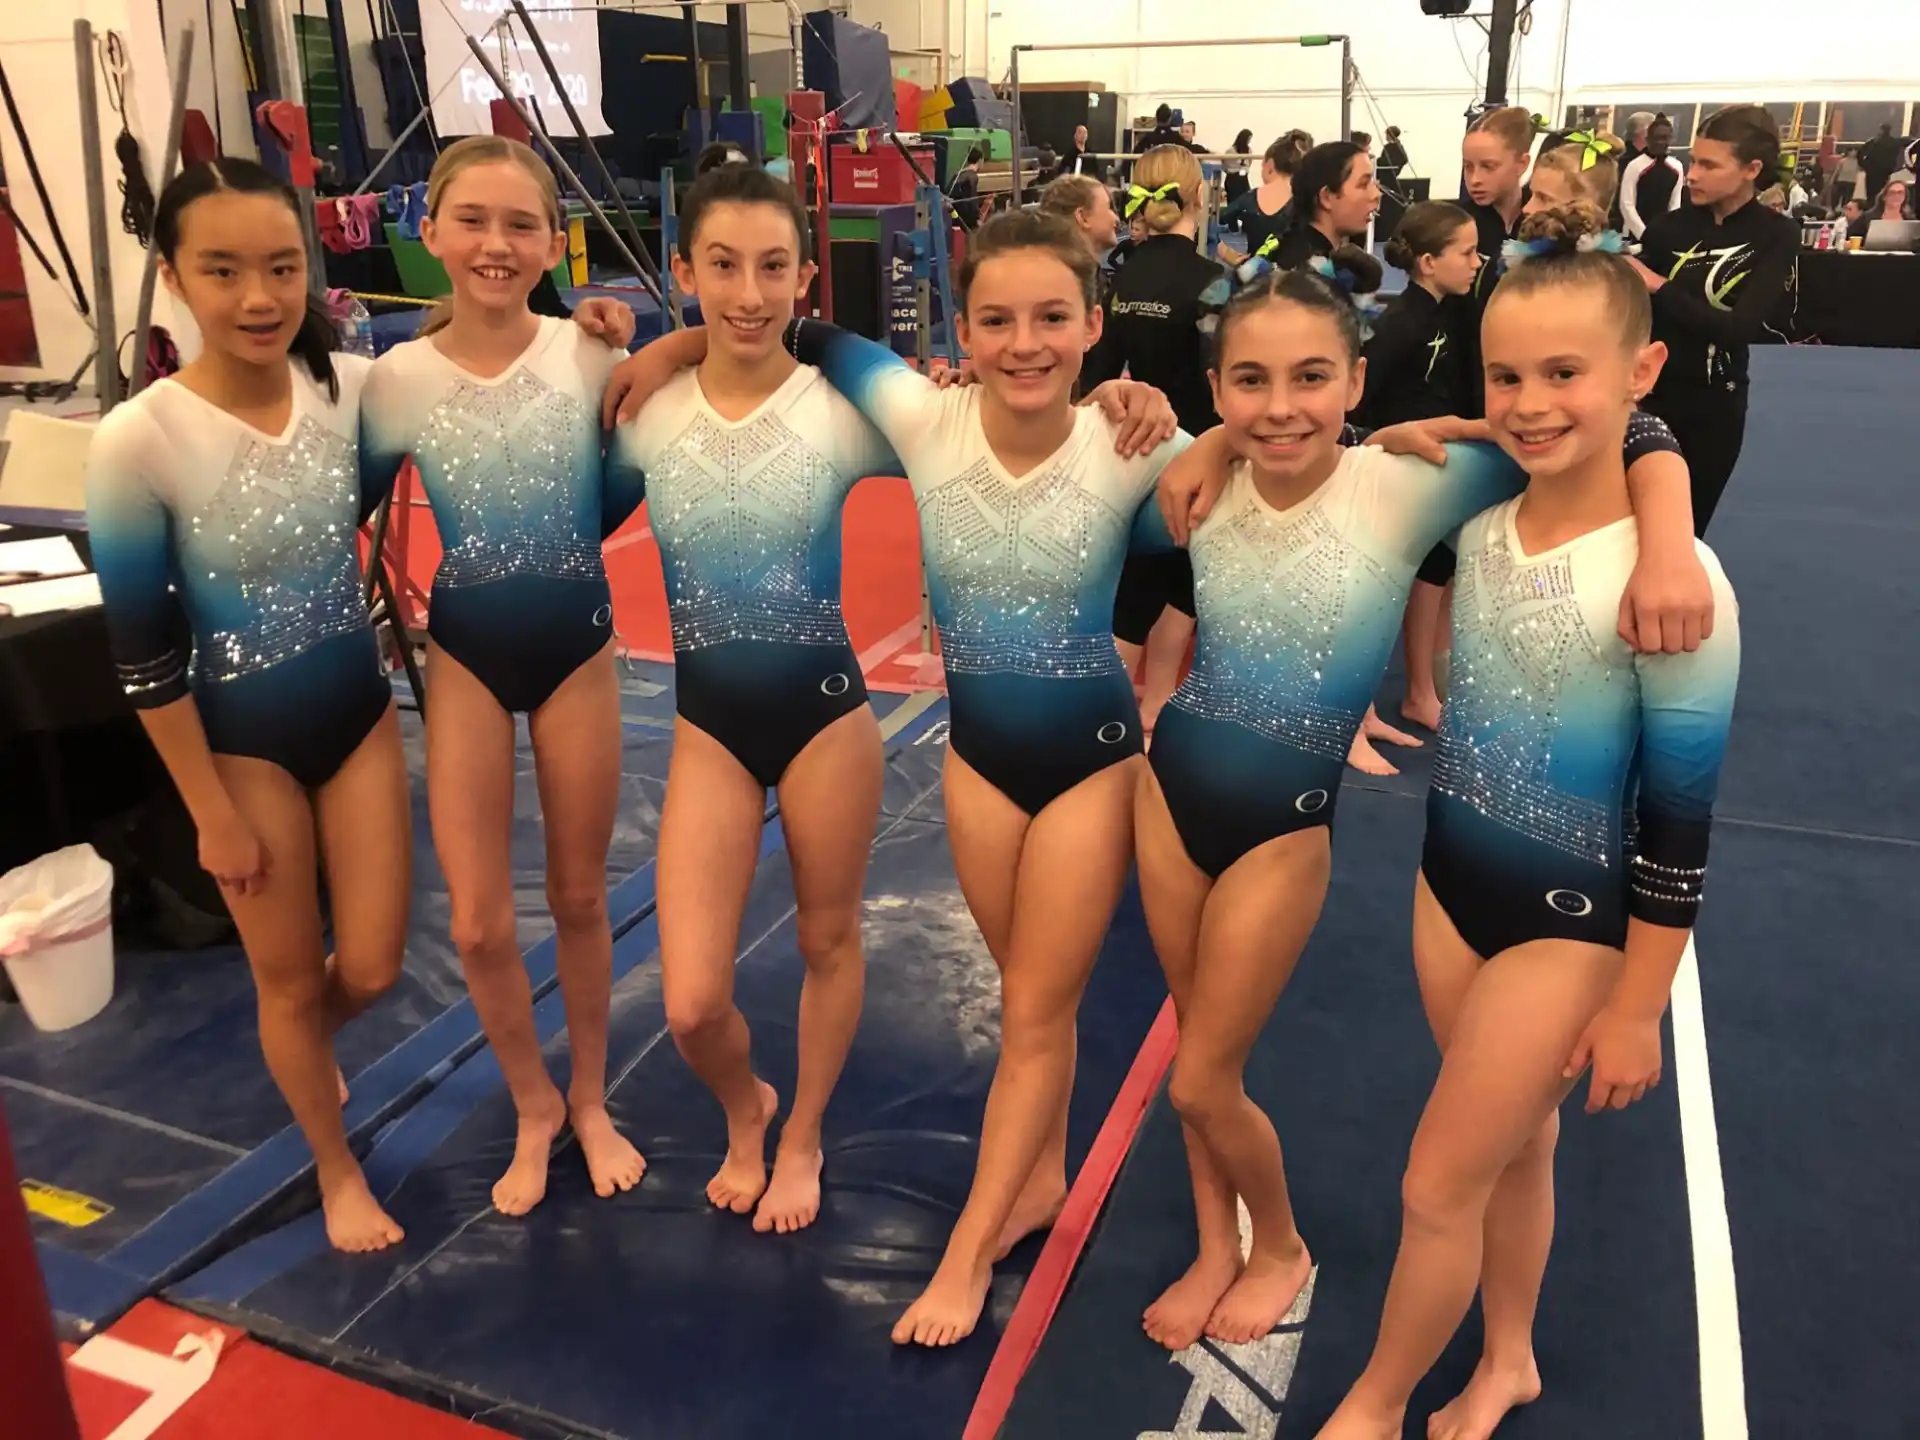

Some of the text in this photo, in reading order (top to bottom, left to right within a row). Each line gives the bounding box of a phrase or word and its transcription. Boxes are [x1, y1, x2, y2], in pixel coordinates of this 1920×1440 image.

[544, 73, 588, 106] 220
[892, 309, 917, 318] ace
[1119, 301, 1171, 314] gymnastics
